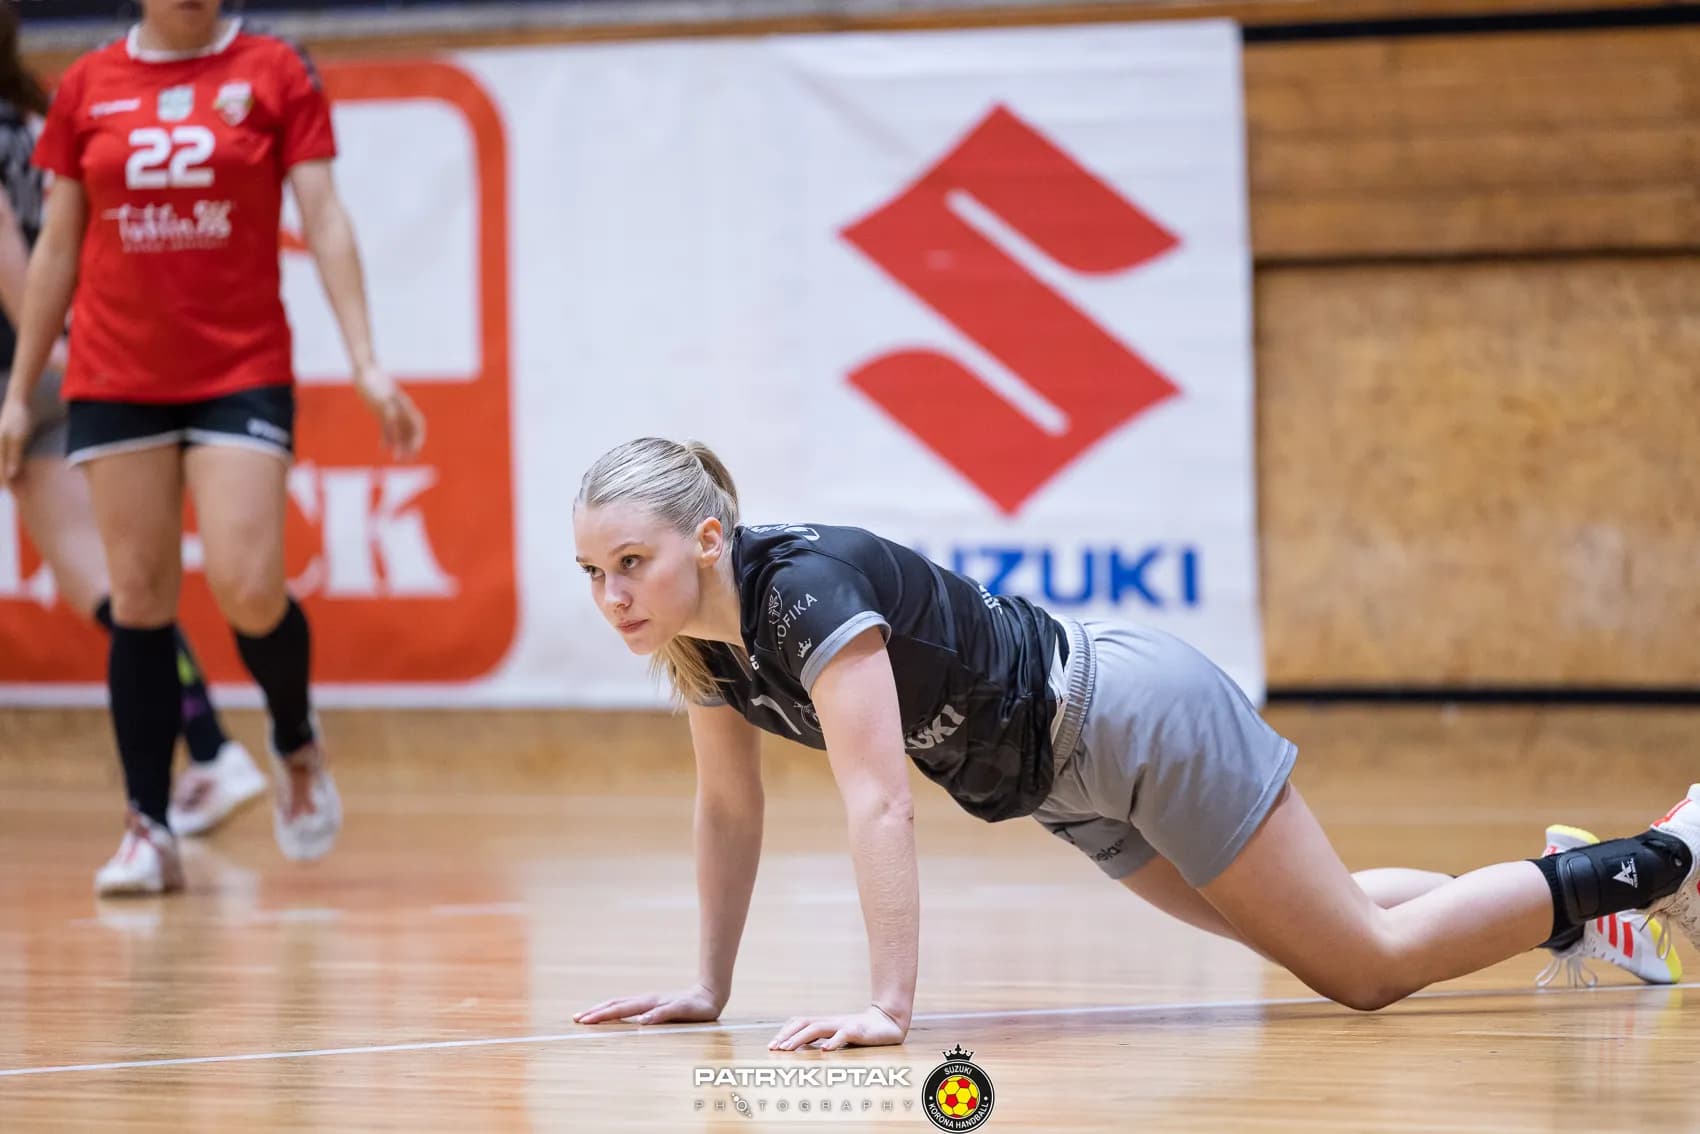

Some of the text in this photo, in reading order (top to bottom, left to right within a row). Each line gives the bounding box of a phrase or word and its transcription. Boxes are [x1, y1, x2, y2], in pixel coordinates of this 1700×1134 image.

[125, 125, 216, 190] 22
[912, 544, 1202, 606] ZUKI
[906, 704, 966, 749] UKI
